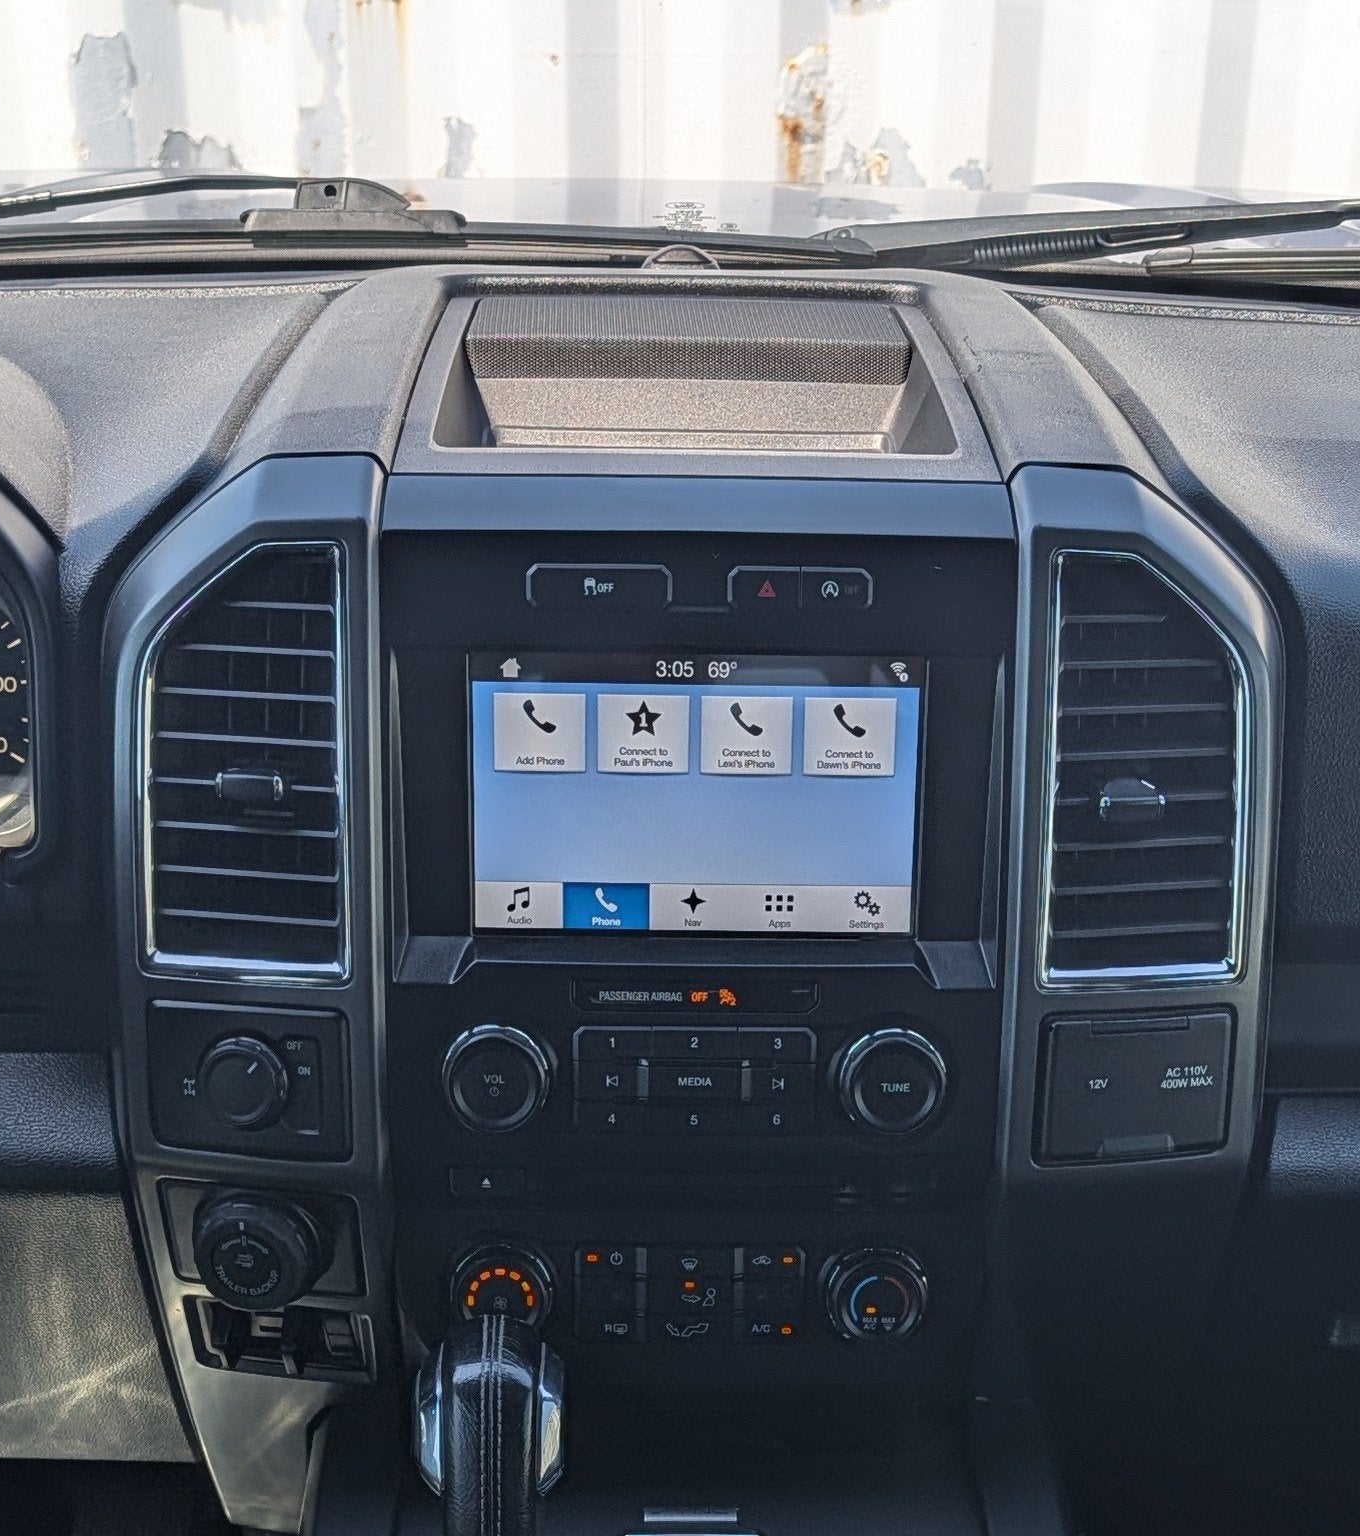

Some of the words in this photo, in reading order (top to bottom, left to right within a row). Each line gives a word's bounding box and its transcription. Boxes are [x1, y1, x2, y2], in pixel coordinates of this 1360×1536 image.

[597, 582, 614, 593] OFF
[655, 661, 694, 678] 3:05
[618, 747, 657, 757] Connect
[659, 747, 669, 757] to
[722, 748, 760, 758] Connect
[762, 748, 772, 758] to
[825, 749, 863, 759] Connect
[865, 750, 875, 759] to
[515, 756, 532, 766] Add
[534, 756, 565, 766] Phone
[614, 757, 640, 768] Paul's
[642, 757, 674, 768] iPhone
[717, 758, 742, 769] Lexi's
[744, 759, 776, 769] iPhone
[816, 759, 849, 770] Dawn's
[851, 760, 882, 770] iPhone
[507, 915, 533, 925] Audio
[591, 916, 621, 927] Phone
[684, 917, 702, 928] Nav
[768, 918, 791, 929] Apps
[848, 919, 885, 931] Settings
[599, 990, 649, 1002] PASSENGER
[651, 991, 683, 1002] AIRBAG
[691, 991, 708, 1002] OFF
[286, 1040, 303, 1051] OFF
[609, 1038, 616, 1048] 1
[690, 1038, 699, 1048] 2
[773, 1039, 782, 1049] 3
[298, 1065, 311, 1076] ON
[1166, 1068, 1181, 1077] AC
[1184, 1065, 1208, 1076] 110V
[483, 1074, 505, 1085] VOL
[678, 1076, 713, 1087] MEDIA
[1089, 1079, 1108, 1089] 12V
[1160, 1079, 1188, 1090] 400W
[1190, 1076, 1214, 1087] MAX
[881, 1082, 911, 1093] TUNE
[608, 1113, 617, 1124] 4
[690, 1114, 699, 1125] 5
[772, 1114, 781, 1125] 6
[214, 1265, 248, 1295] TRAILER
[249, 1269, 280, 1295] BACKUP
[751, 1323, 771, 1334] A/C
